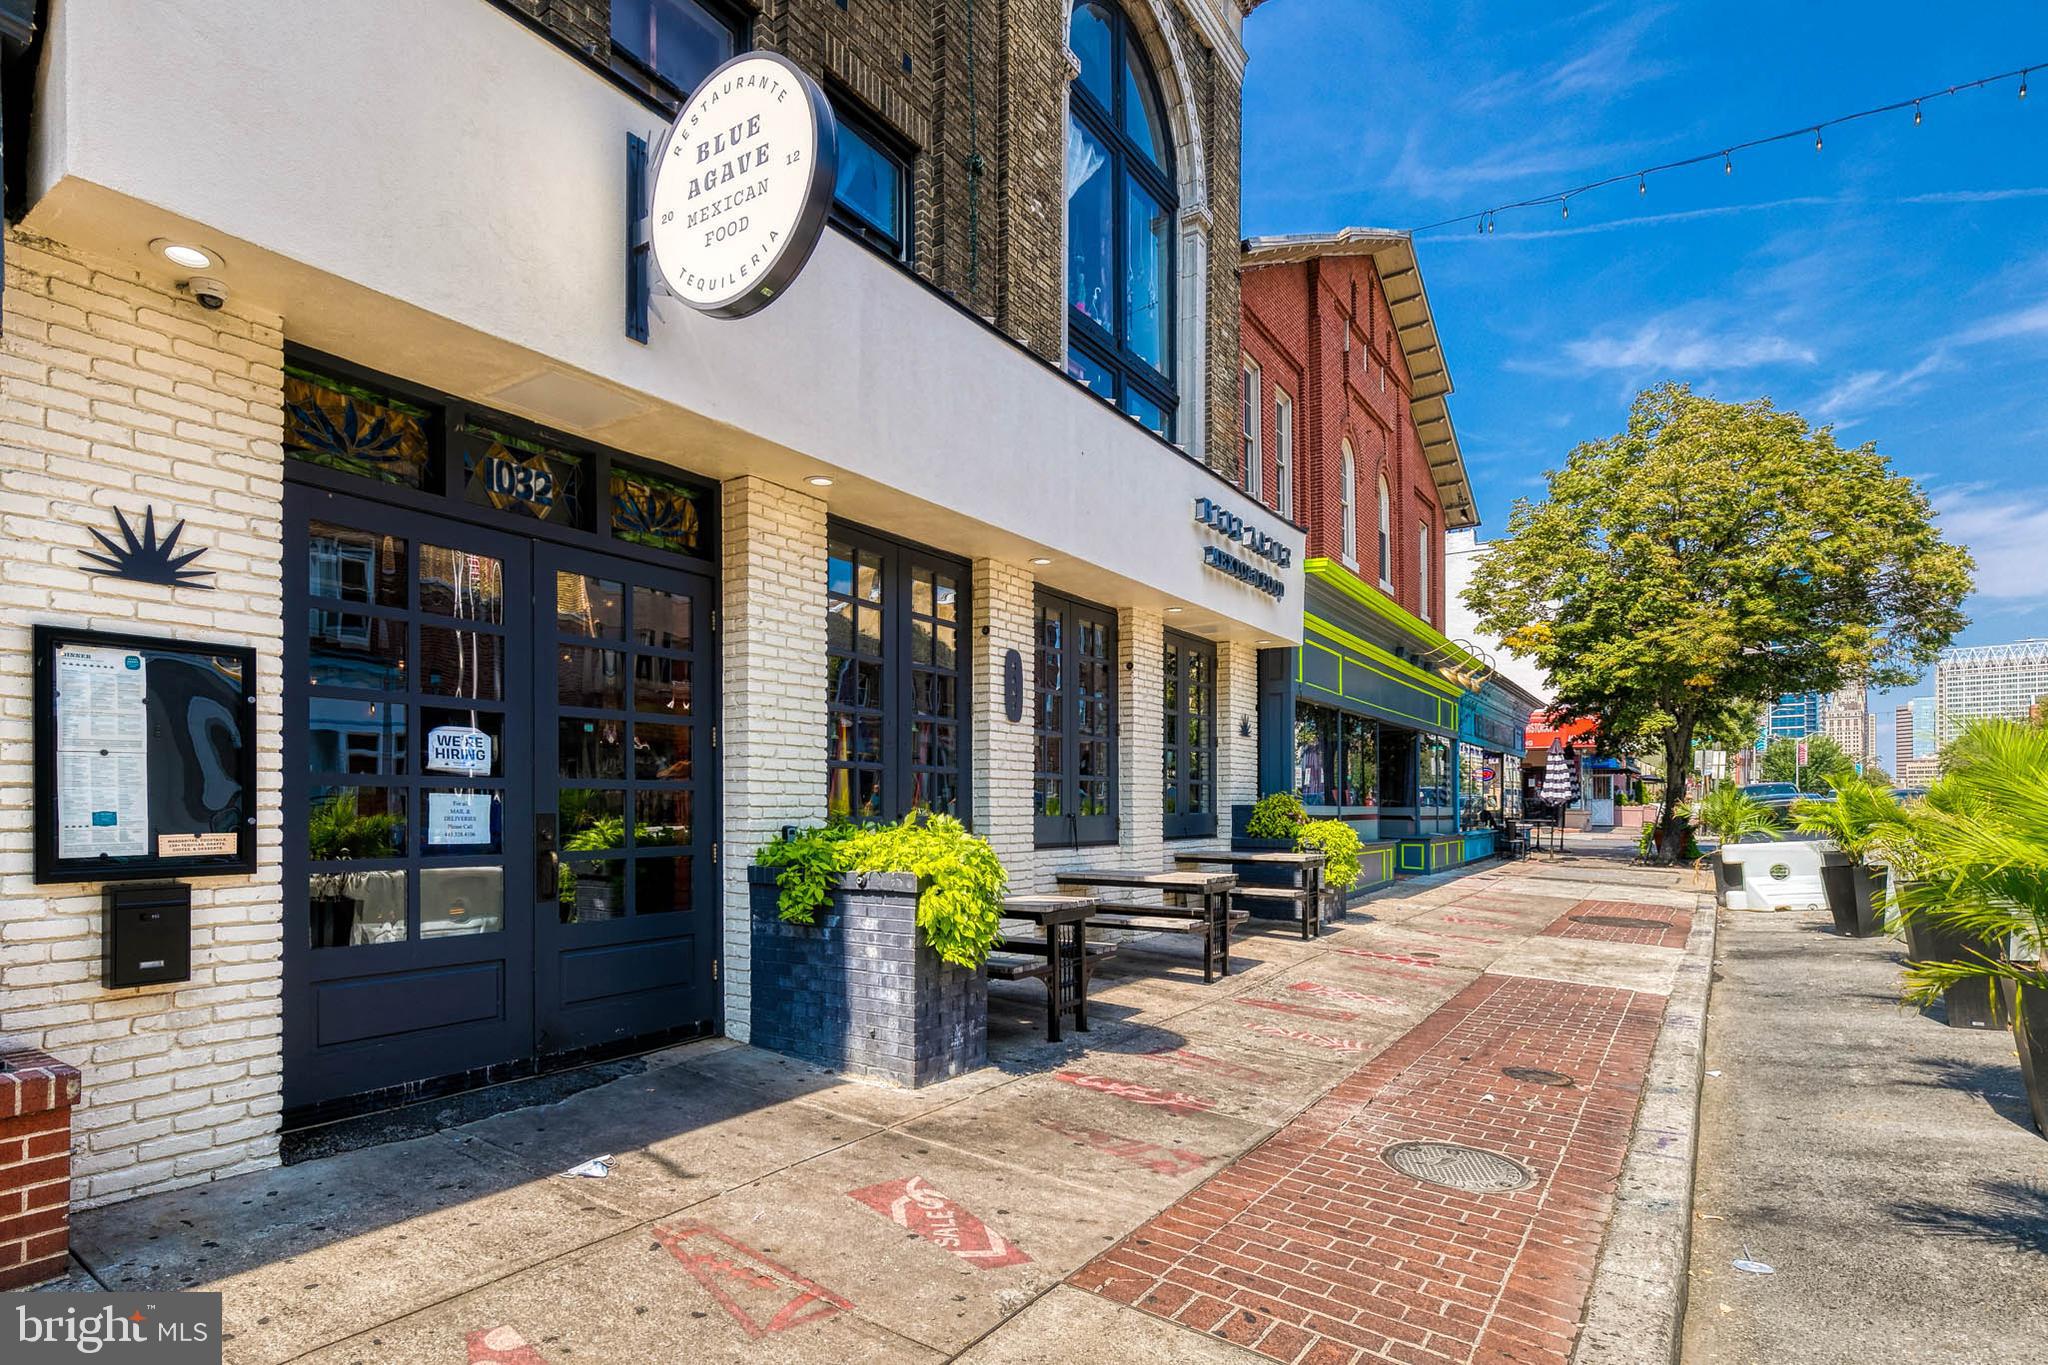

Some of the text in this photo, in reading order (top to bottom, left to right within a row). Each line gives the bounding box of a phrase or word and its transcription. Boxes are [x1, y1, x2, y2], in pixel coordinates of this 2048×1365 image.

[673, 74, 788, 157] RESTAURANTE
[696, 113, 761, 165] BLUE
[785, 150, 801, 166] 12
[687, 142, 770, 200] AGAVE
[661, 210, 674, 226] 20
[687, 178, 769, 229] MEXICAN
[704, 215, 749, 248] FOOD
[678, 228, 779, 292] TEQUILERIA
[485, 456, 554, 505] 1032
[435, 747, 486, 760] HIRING
[437, 735, 483, 748] WE'RE
[925, 1208, 961, 1248] SALE
